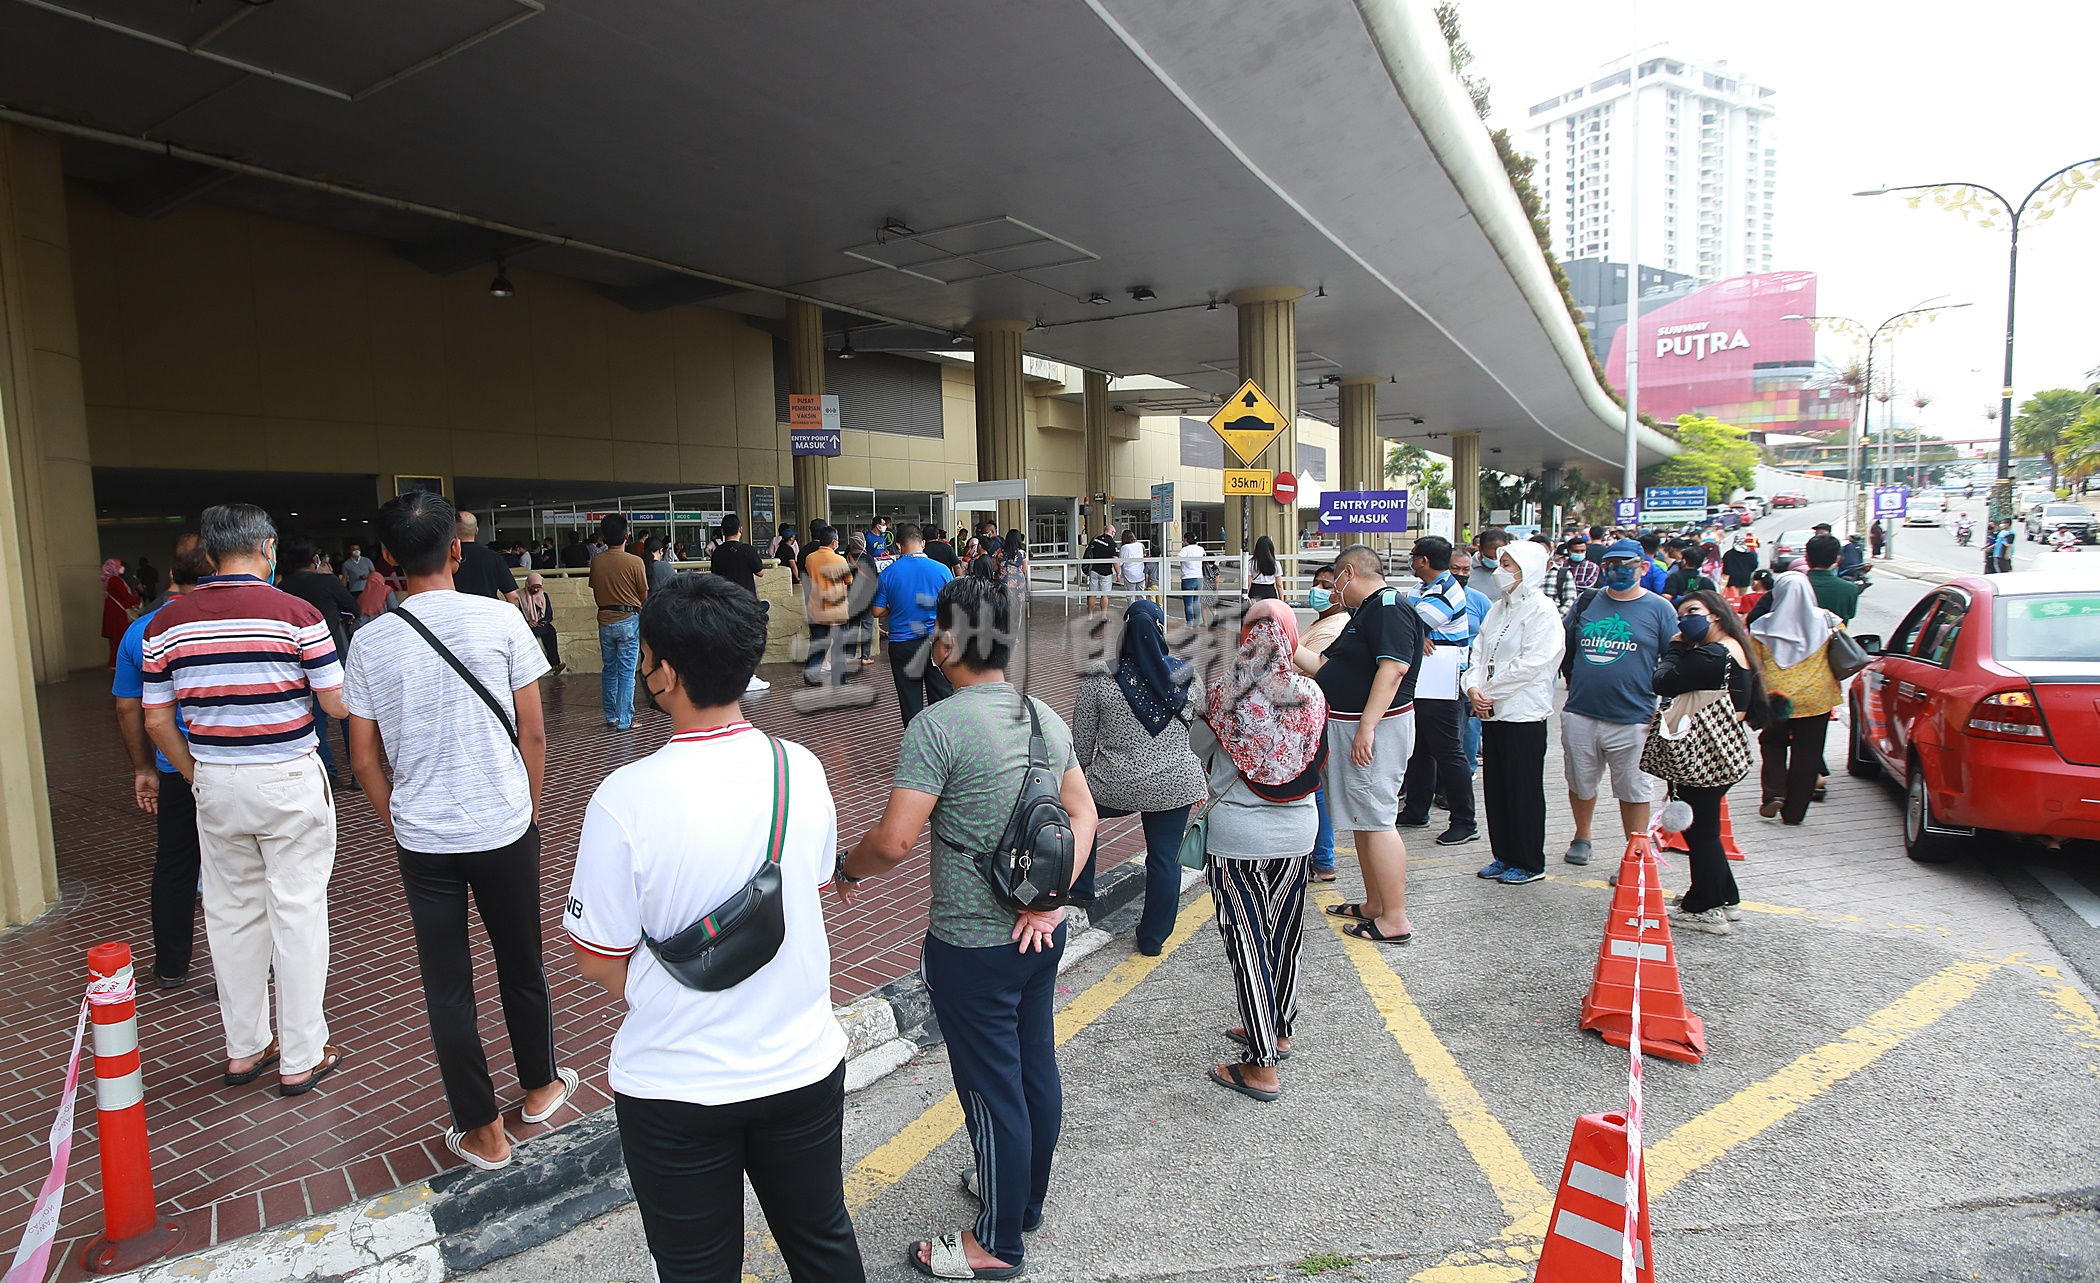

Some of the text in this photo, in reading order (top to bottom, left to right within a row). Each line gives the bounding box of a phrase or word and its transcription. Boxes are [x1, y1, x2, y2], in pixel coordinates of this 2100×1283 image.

[1656, 321, 1710, 336] SUNWAY
[1656, 328, 1750, 361] PUTRA
[1231, 477, 1265, 491] 35km/j
[1333, 499, 1406, 510] ENTRY POINT
[1349, 514, 1389, 524] MASUK
[1581, 637, 1638, 651] california
